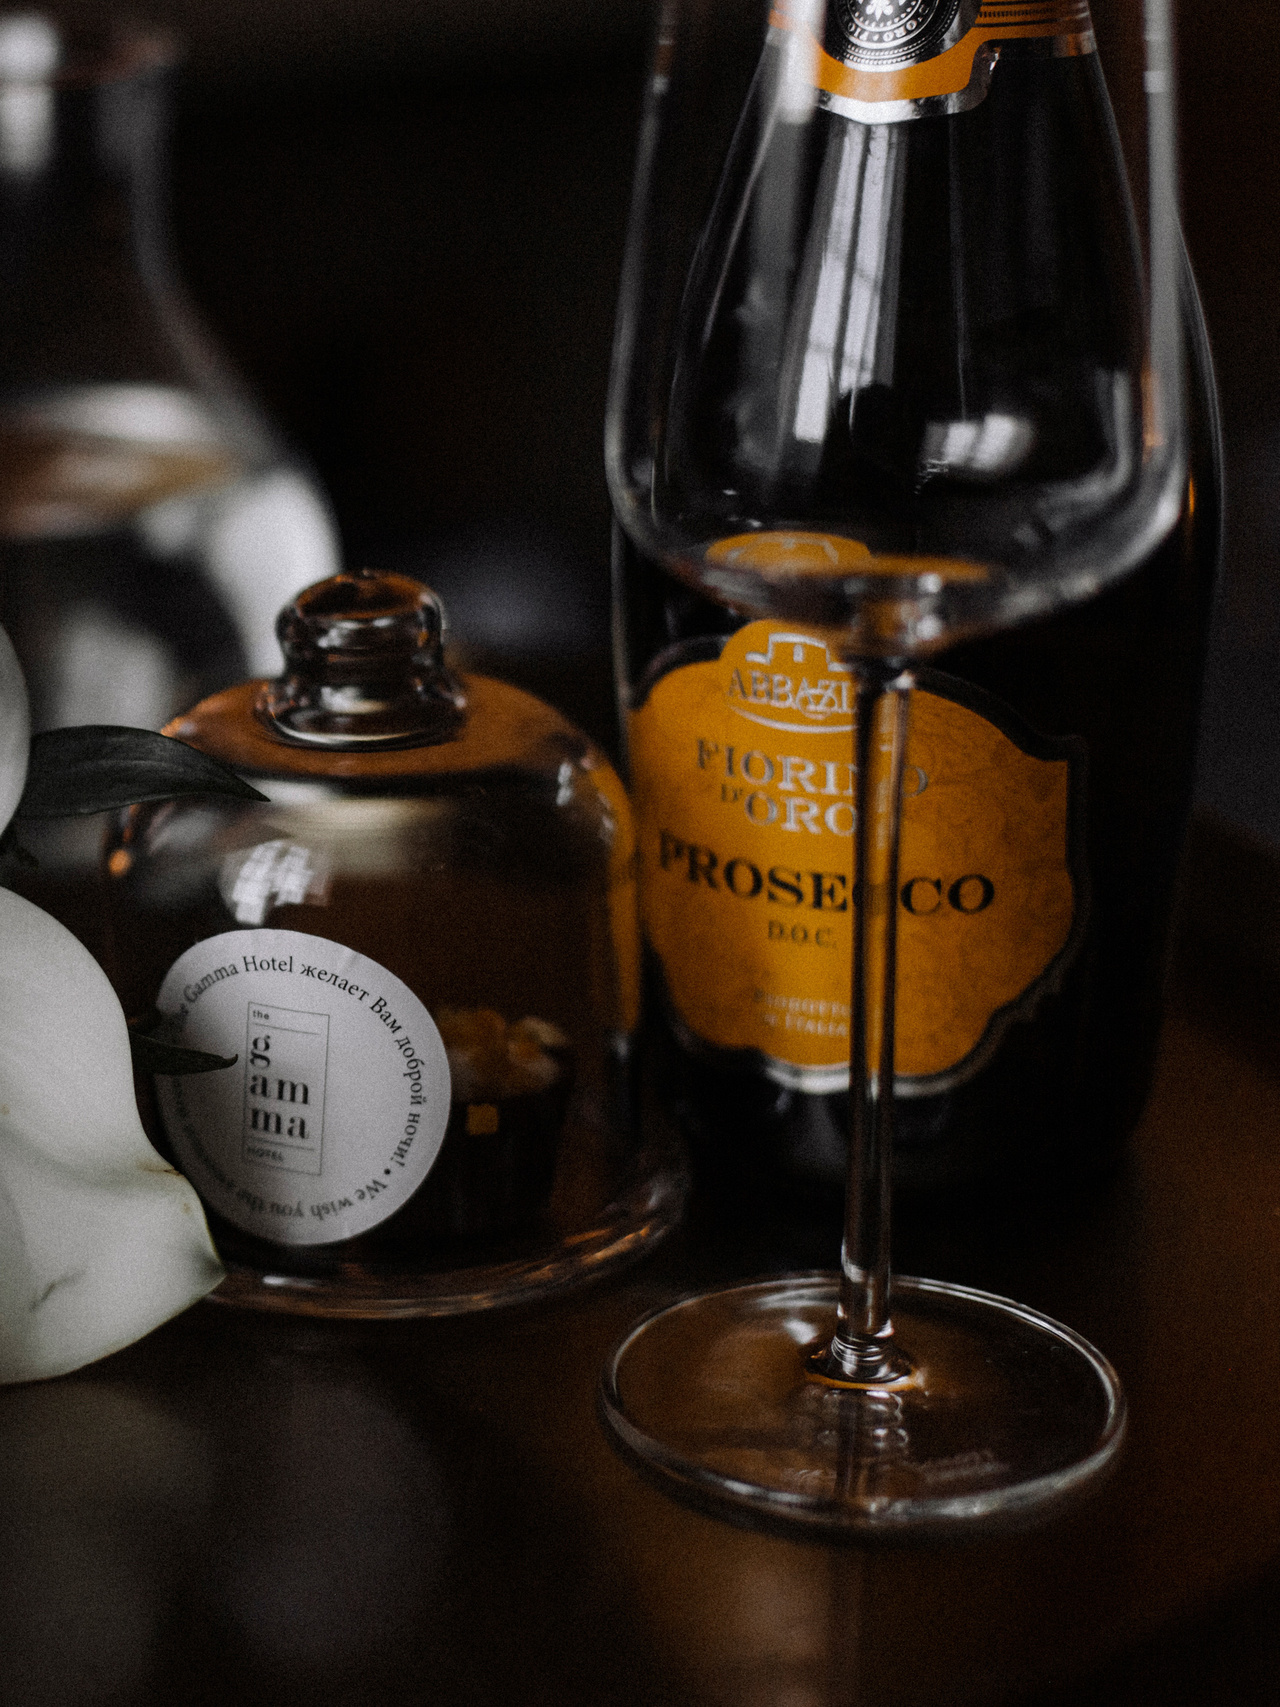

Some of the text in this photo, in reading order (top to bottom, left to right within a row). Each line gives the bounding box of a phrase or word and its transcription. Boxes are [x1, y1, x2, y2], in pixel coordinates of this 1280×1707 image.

[725, 668, 858, 714] ABBAZI
[697, 738, 929, 798] FIORIO
[659, 829, 995, 916] PROSECO
[252, 1009, 270, 1021] the
[183, 955, 427, 1168] Gamma Hotel желает Вам доброй ночи!
[249, 1034, 271, 1070] g
[249, 1074, 311, 1106] am
[248, 1107, 310, 1140] ma
[354, 1179, 388, 1202] We
[311, 1198, 354, 1220] wish
